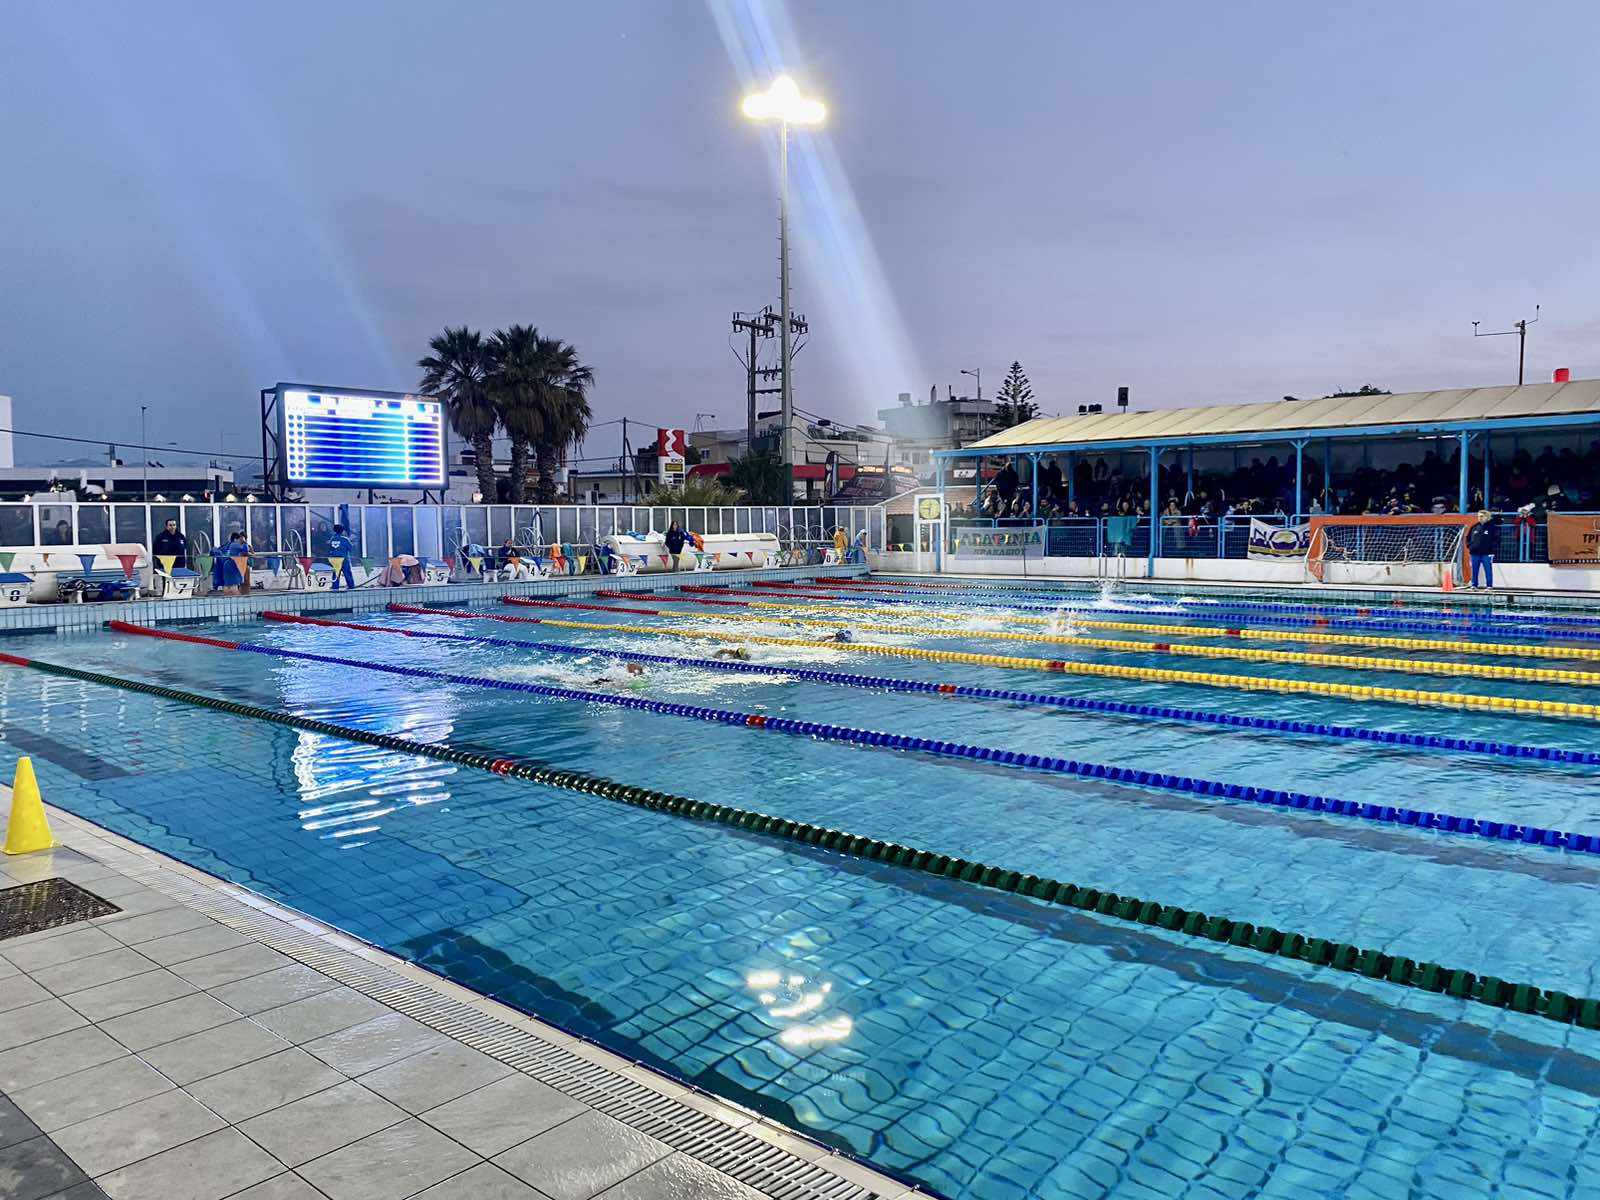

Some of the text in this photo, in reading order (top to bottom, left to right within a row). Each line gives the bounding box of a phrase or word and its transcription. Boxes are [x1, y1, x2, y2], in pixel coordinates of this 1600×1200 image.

[1583, 533, 1600, 543] ΤΡΙ
[530, 567, 535, 576] 4
[620, 563, 625, 572] 3
[307, 575, 312, 586] 6
[427, 571, 431, 582] 5
[178, 584, 187, 594] 7
